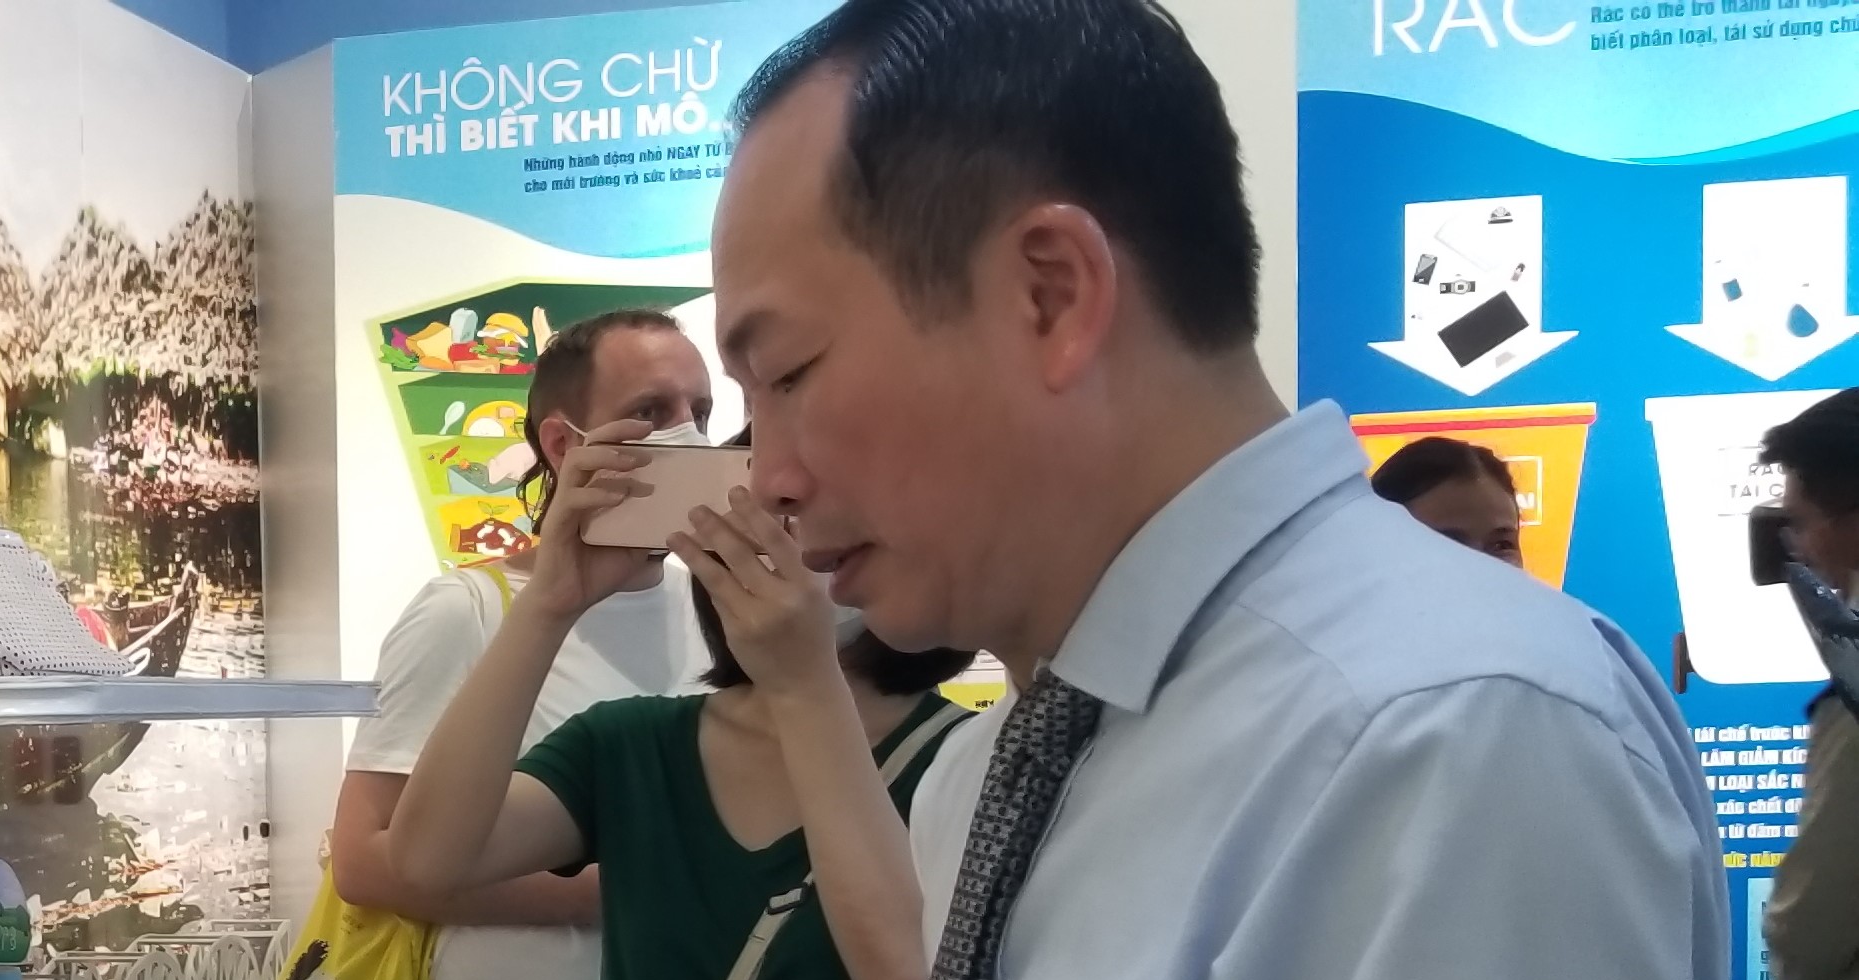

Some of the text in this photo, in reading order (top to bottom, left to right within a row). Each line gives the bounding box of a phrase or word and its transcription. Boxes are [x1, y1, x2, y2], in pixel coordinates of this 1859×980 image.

[383, 36, 723, 117] KHÔNG CHỪ
[385, 112, 446, 157] THÌ
[460, 100, 539, 151] BIẾT
[552, 106, 622, 144] KHI
[667, 144, 700, 160] NGAY
